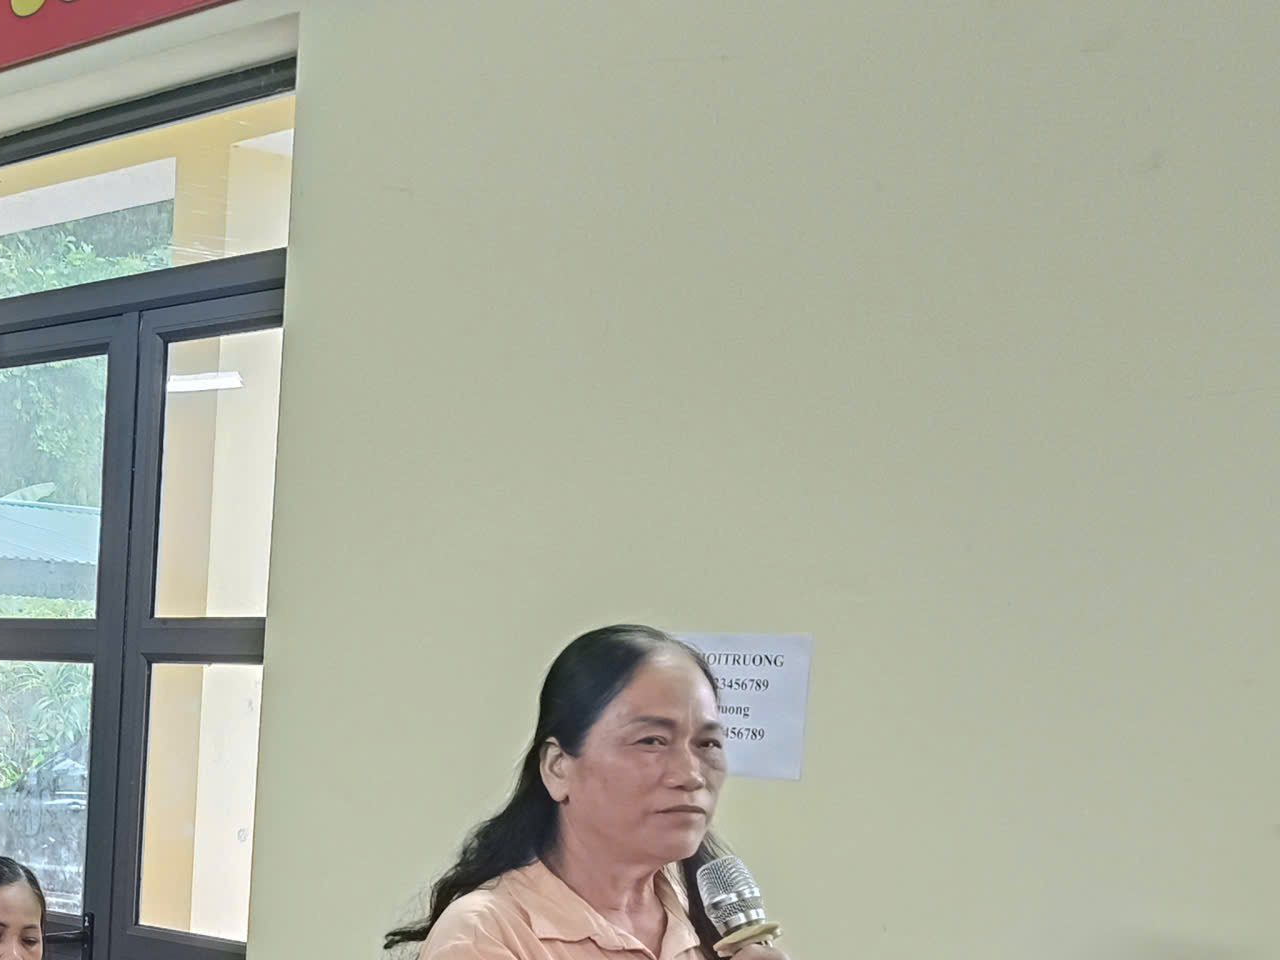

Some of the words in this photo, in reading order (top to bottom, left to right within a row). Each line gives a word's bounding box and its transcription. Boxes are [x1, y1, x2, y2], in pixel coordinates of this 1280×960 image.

[704, 652, 785, 668] OITRUONG
[713, 677, 769, 692] 23456789
[718, 704, 751, 718] uong
[722, 726, 765, 741] 456789
